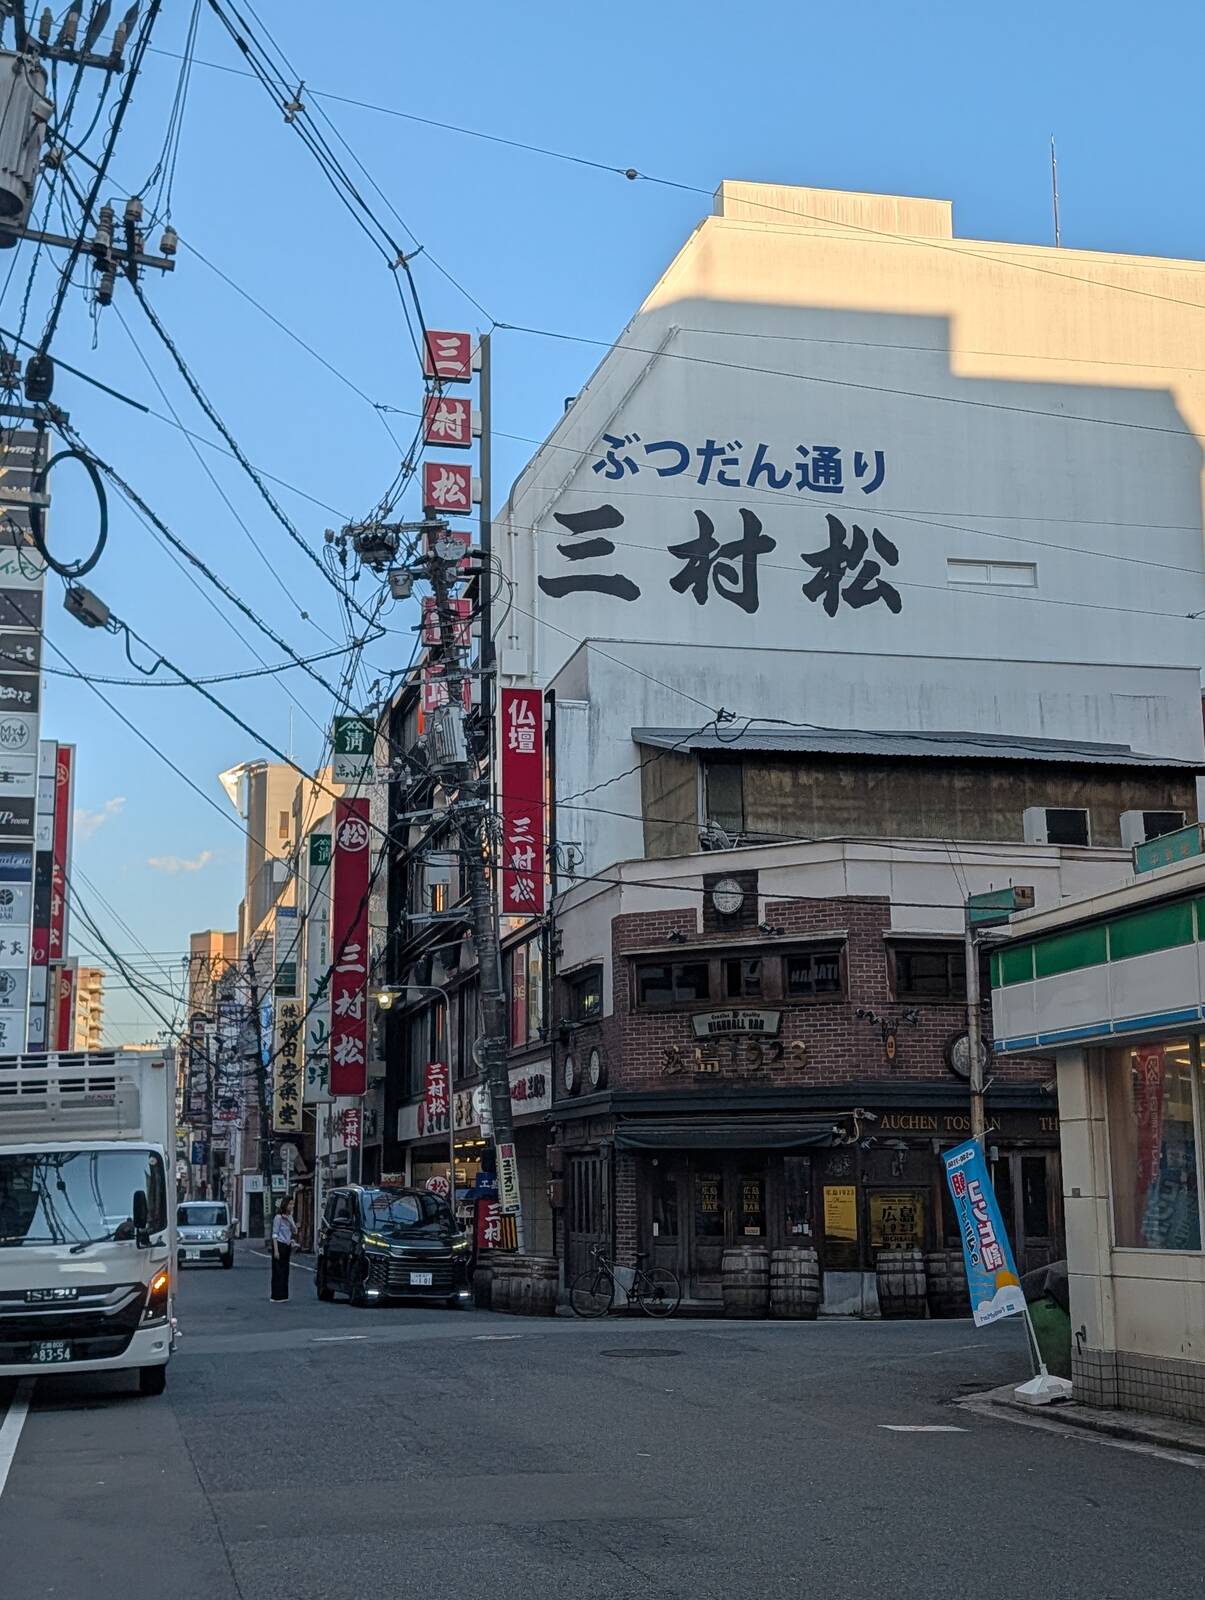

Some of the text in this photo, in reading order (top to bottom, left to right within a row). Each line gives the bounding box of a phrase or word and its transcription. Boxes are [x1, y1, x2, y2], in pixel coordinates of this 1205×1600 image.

[431, 337, 467, 506] 三村松
[592, 433, 887, 494] ぶつだん通り
[538, 504, 903, 618] 三村松
[509, 699, 537, 754] 仏壇
[340, 823, 366, 847] 松
[508, 817, 536, 903] 三村松
[334, 944, 365, 1067] 三村松
[427, 1063, 447, 1114] 三村松
[880, 1115, 938, 1130] AUCHEN
[944, 1115, 1001, 1131] TOSAN
[26, 1289, 77, 1300] ISUZU
